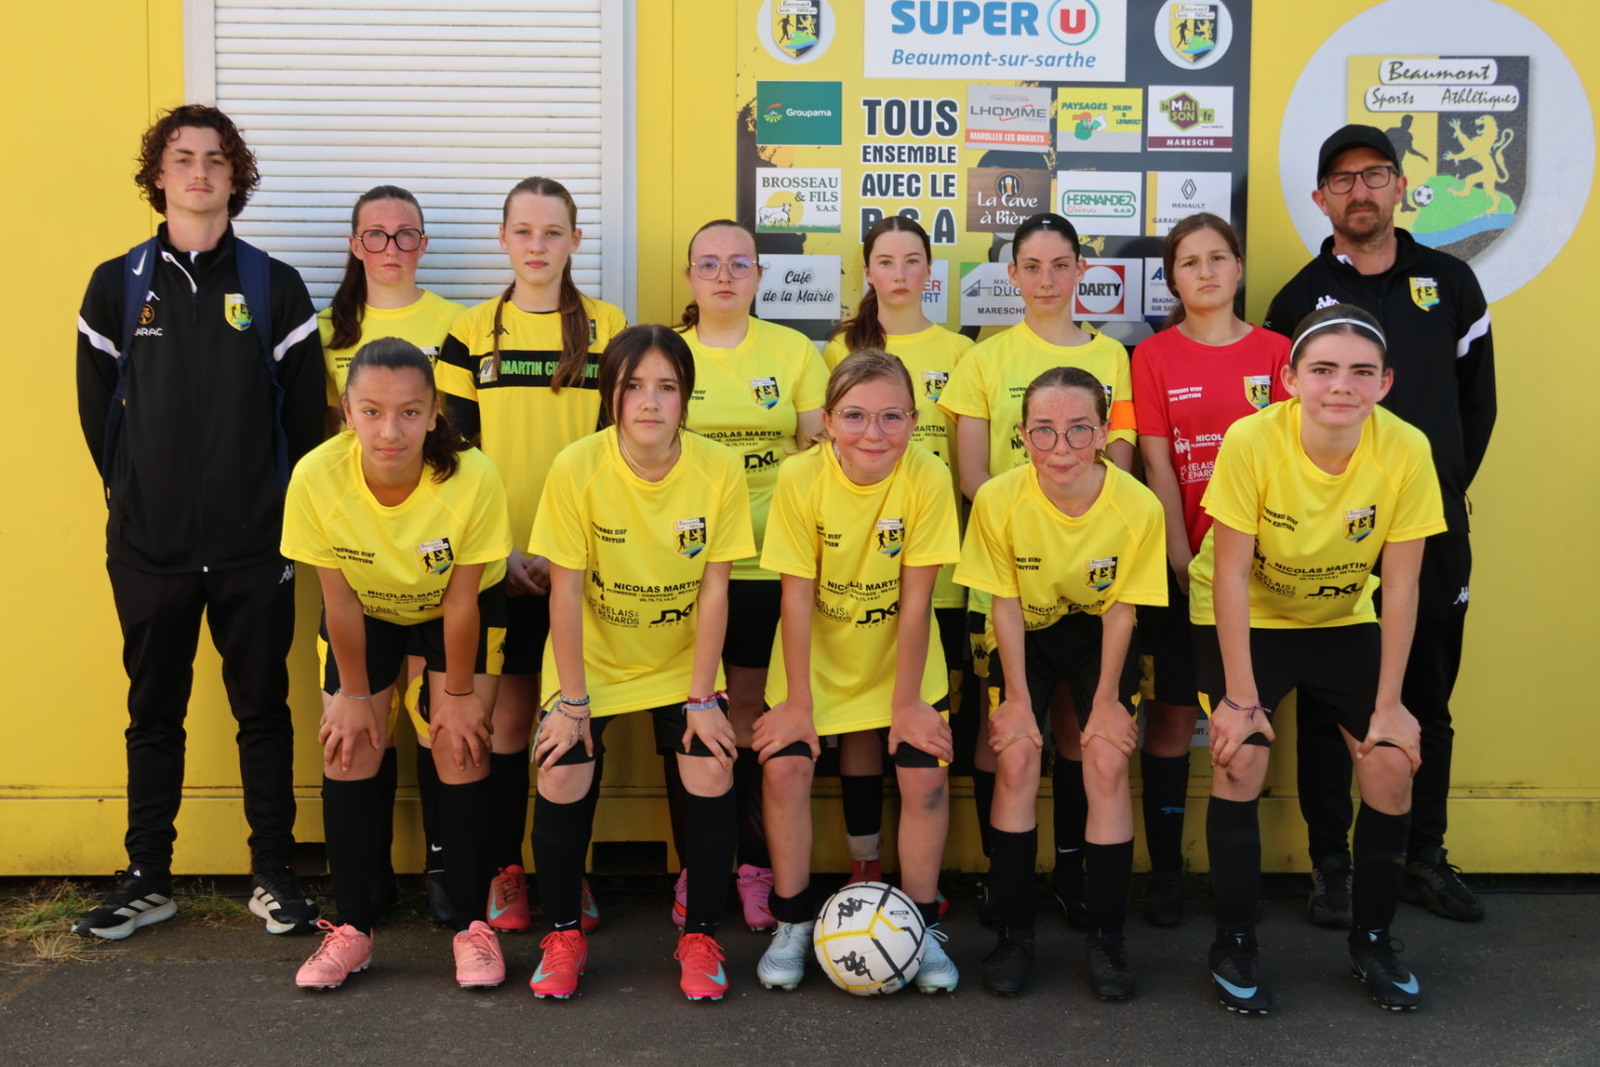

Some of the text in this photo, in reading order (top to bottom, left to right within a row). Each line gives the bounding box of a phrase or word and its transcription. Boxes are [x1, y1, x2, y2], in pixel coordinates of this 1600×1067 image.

[891, 0, 1087, 36] SUPER U
[891, 48, 1096, 68] Beaumont-sur-sarthe
[1388, 60, 1490, 81] Beaumont
[1372, 87, 1415, 109] Sports
[970, 105, 1047, 118] LHOMME
[1061, 102, 1108, 110] PAYSAGES
[786, 108, 832, 118] Groupama
[861, 99, 958, 136] TOUS
[970, 131, 1045, 143] MAROLLES LES BRAULTS
[1166, 138, 1215, 146] MARESCHE
[862, 145, 956, 163] ENSEMBLE
[761, 176, 839, 189] BROSSEAU
[861, 173, 956, 198] AVEC LE
[794, 191, 839, 202] & FILS
[977, 191, 1039, 208] La Cave
[980, 209, 1032, 225] à Bièr
[993, 285, 1022, 296] DUG
[1078, 282, 1121, 296] DARTY
[762, 290, 834, 303] de la Mairie
[134, 327, 163, 336] ARAC
[500, 360, 542, 375] MARTIN
[1195, 433, 1223, 442] NICOL
[1275, 562, 1367, 573] NICOLAS MARTIN
[367, 588, 446, 599] NICOLAS MART
[614, 582, 660, 593] NICOLAS
